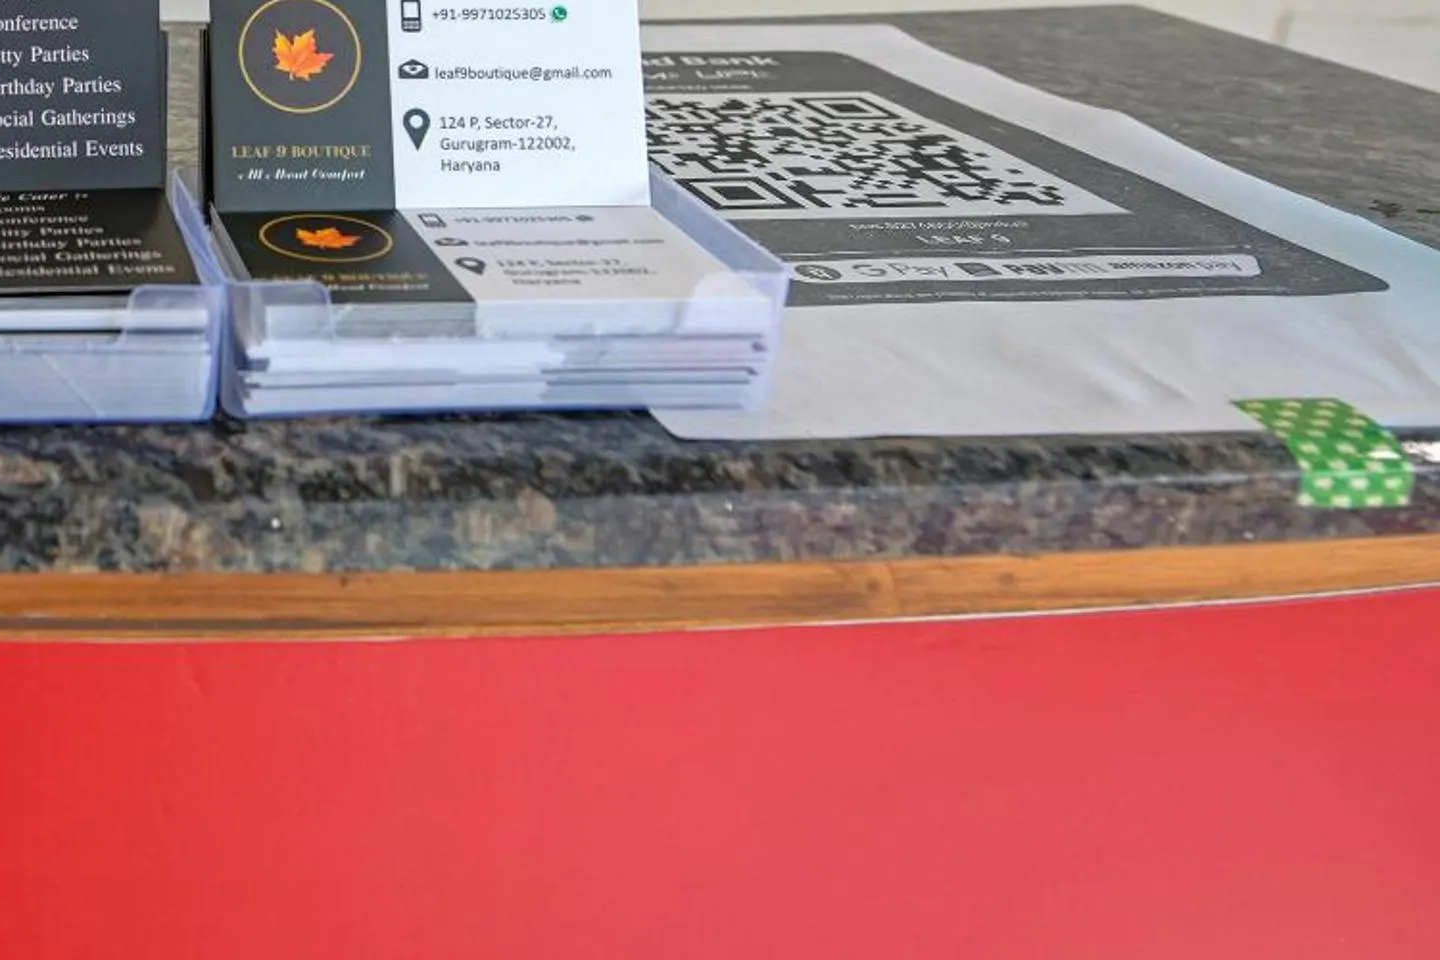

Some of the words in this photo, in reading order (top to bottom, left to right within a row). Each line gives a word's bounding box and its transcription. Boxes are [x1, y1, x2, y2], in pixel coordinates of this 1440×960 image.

[431, 7, 547, 22] +91-9971025305
[30, 45, 90, 64] Parties
[680, 55, 780, 66] Bank
[434, 64, 613, 82] leaf9boutique@gmail.com
[63, 76, 123, 95] Parties
[41, 108, 137, 130] Gatherings
[438, 116, 466, 130] 124
[484, 115, 558, 131] Sector-27,
[85, 139, 144, 158] Events
[231, 145, 271, 159] LEAF
[276, 145, 287, 158] 9
[291, 144, 372, 159] BOUTIQUE
[440, 136, 576, 153] Gurugram-122002,
[311, 166, 365, 182] Comfort
[440, 158, 502, 174] Haryana
[39, 226, 105, 237] Parties
[77, 238, 143, 248] Parties
[55, 251, 163, 263] Gatherings
[108, 264, 176, 276] Events
